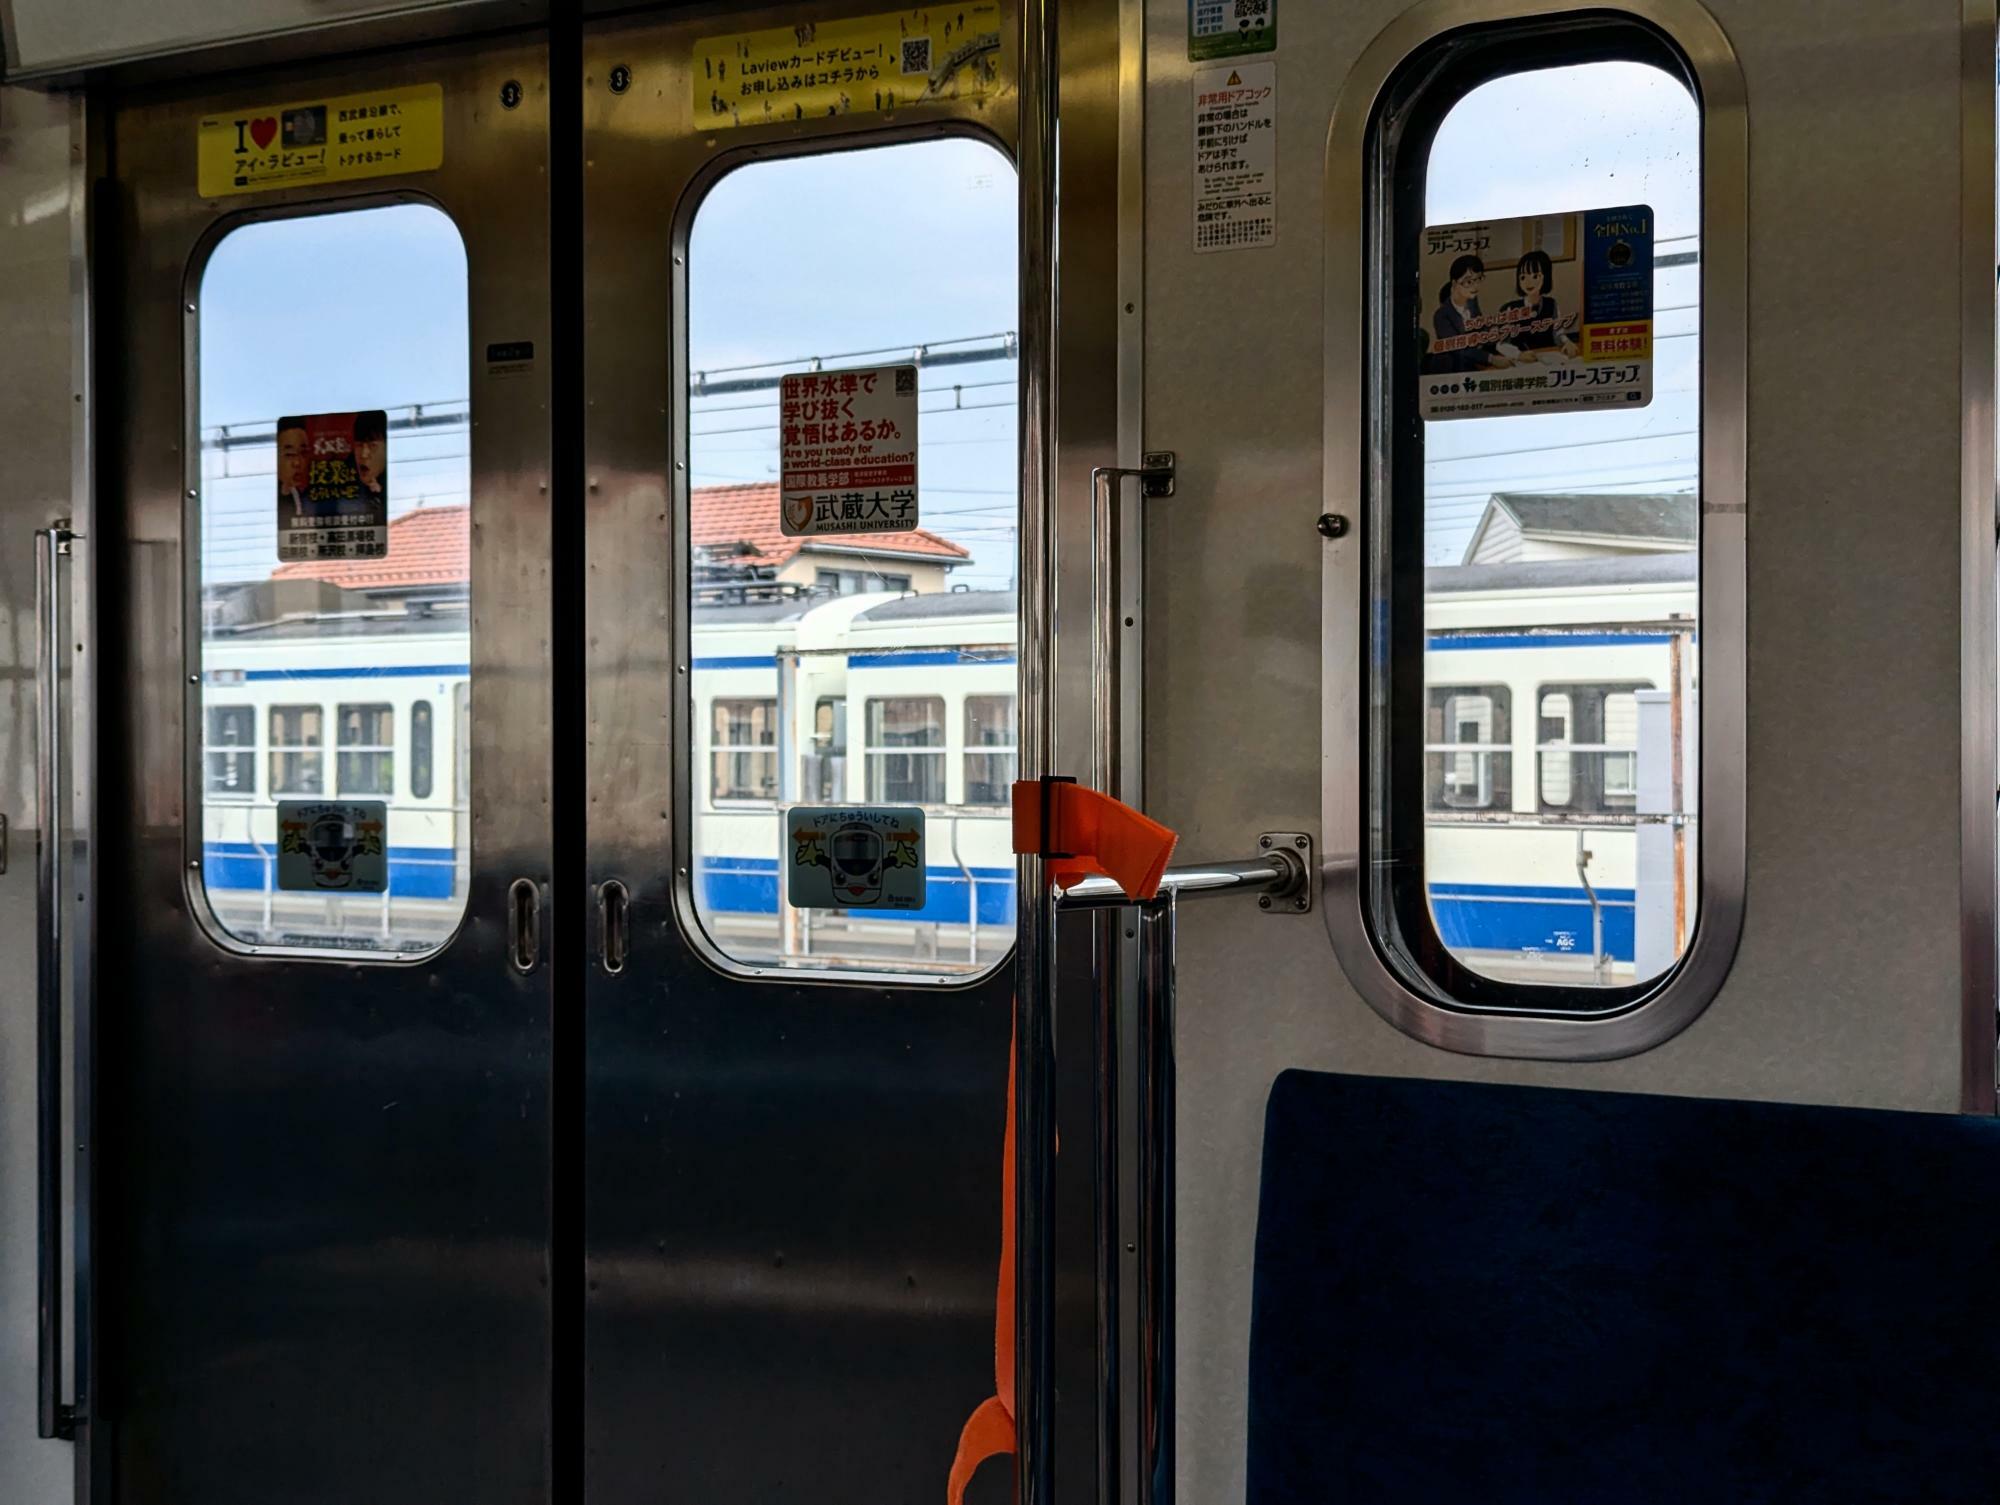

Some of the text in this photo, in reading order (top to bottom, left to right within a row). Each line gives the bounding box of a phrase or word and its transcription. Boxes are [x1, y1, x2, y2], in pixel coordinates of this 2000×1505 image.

[616, 71, 623, 88] 3
[740, 65, 879, 95] お申し込みはコチラから
[1198, 87, 1271, 107] 非常用ドアコック
[1198, 109, 1248, 123] 非常の場合は
[234, 121, 248, 154] I
[1198, 133, 1248, 149] 手前に引けば
[235, 148, 326, 173] アイ・ラビュー!
[339, 148, 401, 166] トクするカード
[1198, 148, 1237, 162] ドアは手で
[1198, 160, 1250, 173] あけられます。
[1198, 197, 1271, 211] みだりに車外へ出ると
[1428, 237, 1489, 255] フリーステップ
[783, 372, 877, 399] 世界水準で
[1479, 376, 1548, 392] 個別指導学院
[1549, 365, 1640, 387] フリーステップ
[783, 397, 854, 423] 学び抜く
[783, 419, 901, 446] 覚悟はあるか。
[784, 444, 873, 459] Are you ready for
[792, 457, 851, 469] world-class
[854, 452, 915, 465] education?
[815, 490, 915, 522] 武蔵大学
[816, 519, 915, 532] MUSASHI UNIVERSITY
[813, 810, 899, 828] ドアにちゅういしてね
[1556, 938, 1575, 946] AGC
